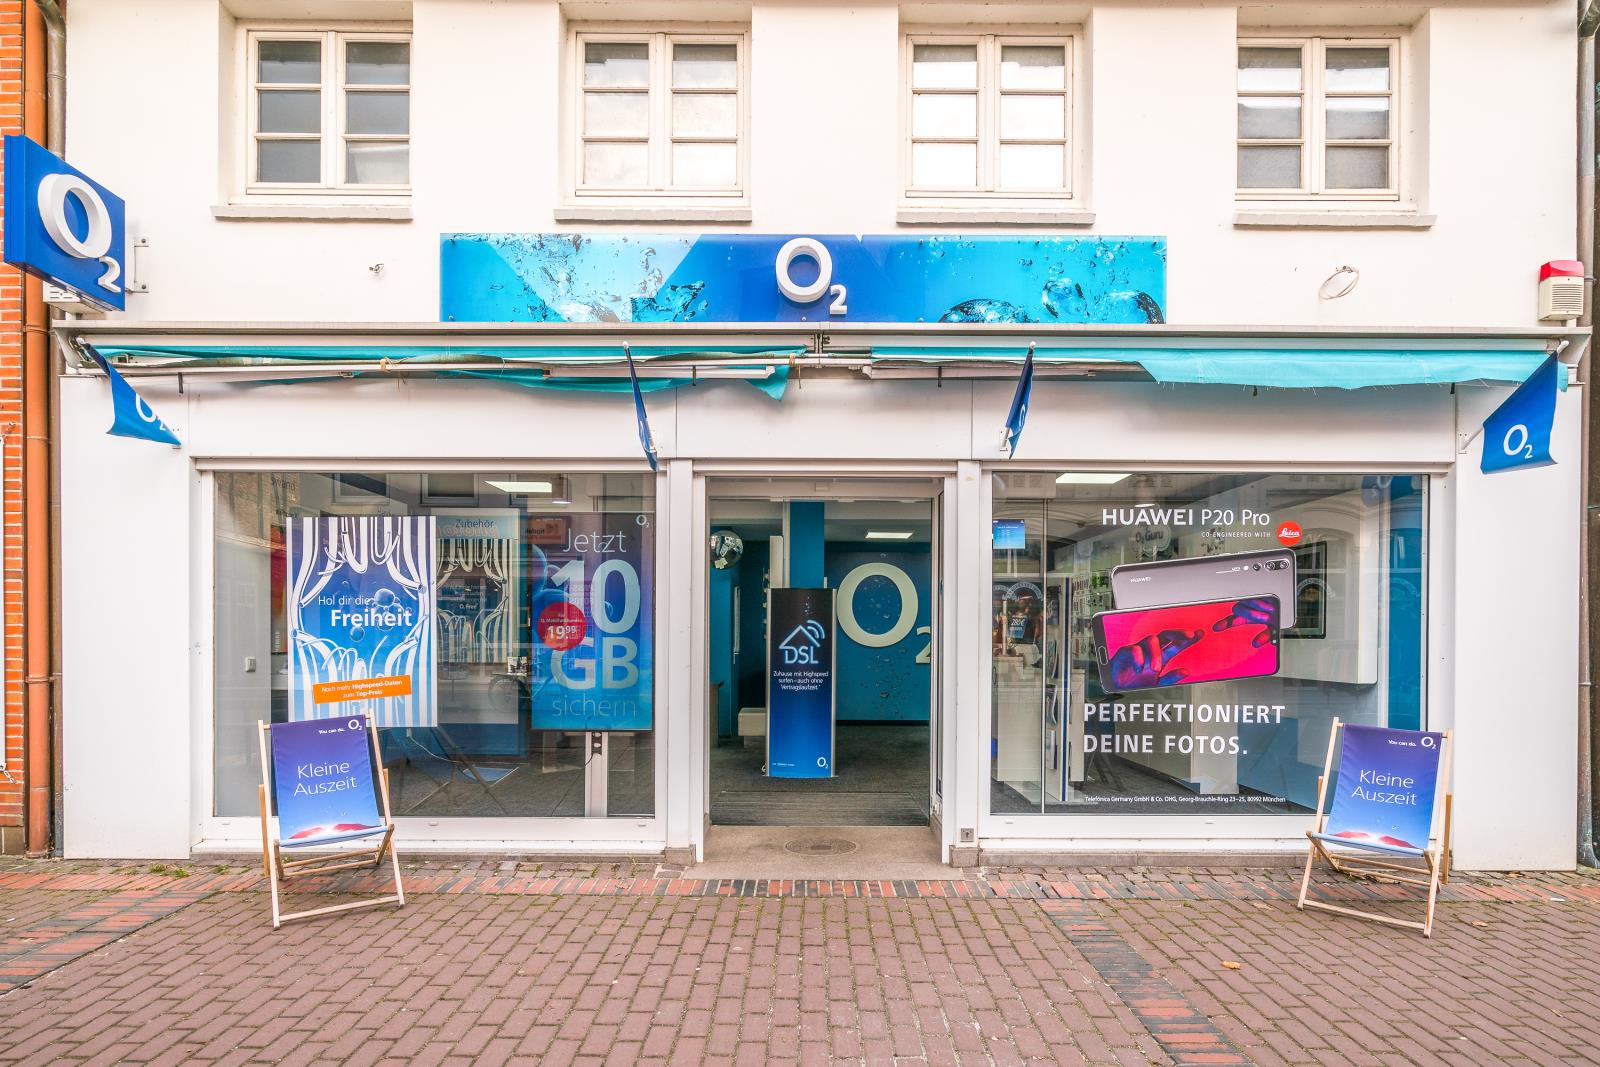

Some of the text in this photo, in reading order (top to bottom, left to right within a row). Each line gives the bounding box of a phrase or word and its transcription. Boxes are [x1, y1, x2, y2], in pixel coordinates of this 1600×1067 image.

[37, 173, 121, 292] O2
[775, 237, 848, 315] O2
[1503, 424, 1533, 459] O2
[455, 518, 494, 529] Zubehör
[635, 514, 650, 528] O2
[1102, 508, 1270, 526] HUAWEI P20 Pro
[562, 527, 627, 553] Jetzt
[1145, 530, 1164, 541] Guru
[1278, 527, 1300, 538] Leica
[318, 595, 370, 606] Hol dir die
[550, 559, 641, 634] 10
[331, 608, 413, 627] Freiheit
[837, 562, 930, 664] O2
[550, 637, 639, 690] GB
[779, 645, 819, 665] DSL
[803, 670, 829, 678] Highspeed
[352, 680, 403, 689] Highspeed-Daten
[355, 689, 383, 698] Top-Preis
[551, 693, 636, 717] sichern
[1083, 703, 1286, 724] PERFEKTIONIERT
[348, 719, 362, 731] O2
[1083, 734, 1248, 755] DEINE FOTOS.
[1421, 736, 1437, 749] O2
[297, 761, 350, 779] Kleine
[817, 756, 828, 769] O2
[294, 776, 358, 797] Auszeit
[1360, 769, 1414, 788] Kleine
[1179, 795, 1228, 803] Georg-Brauchle-Ring
[1351, 785, 1417, 806] Auszeit
